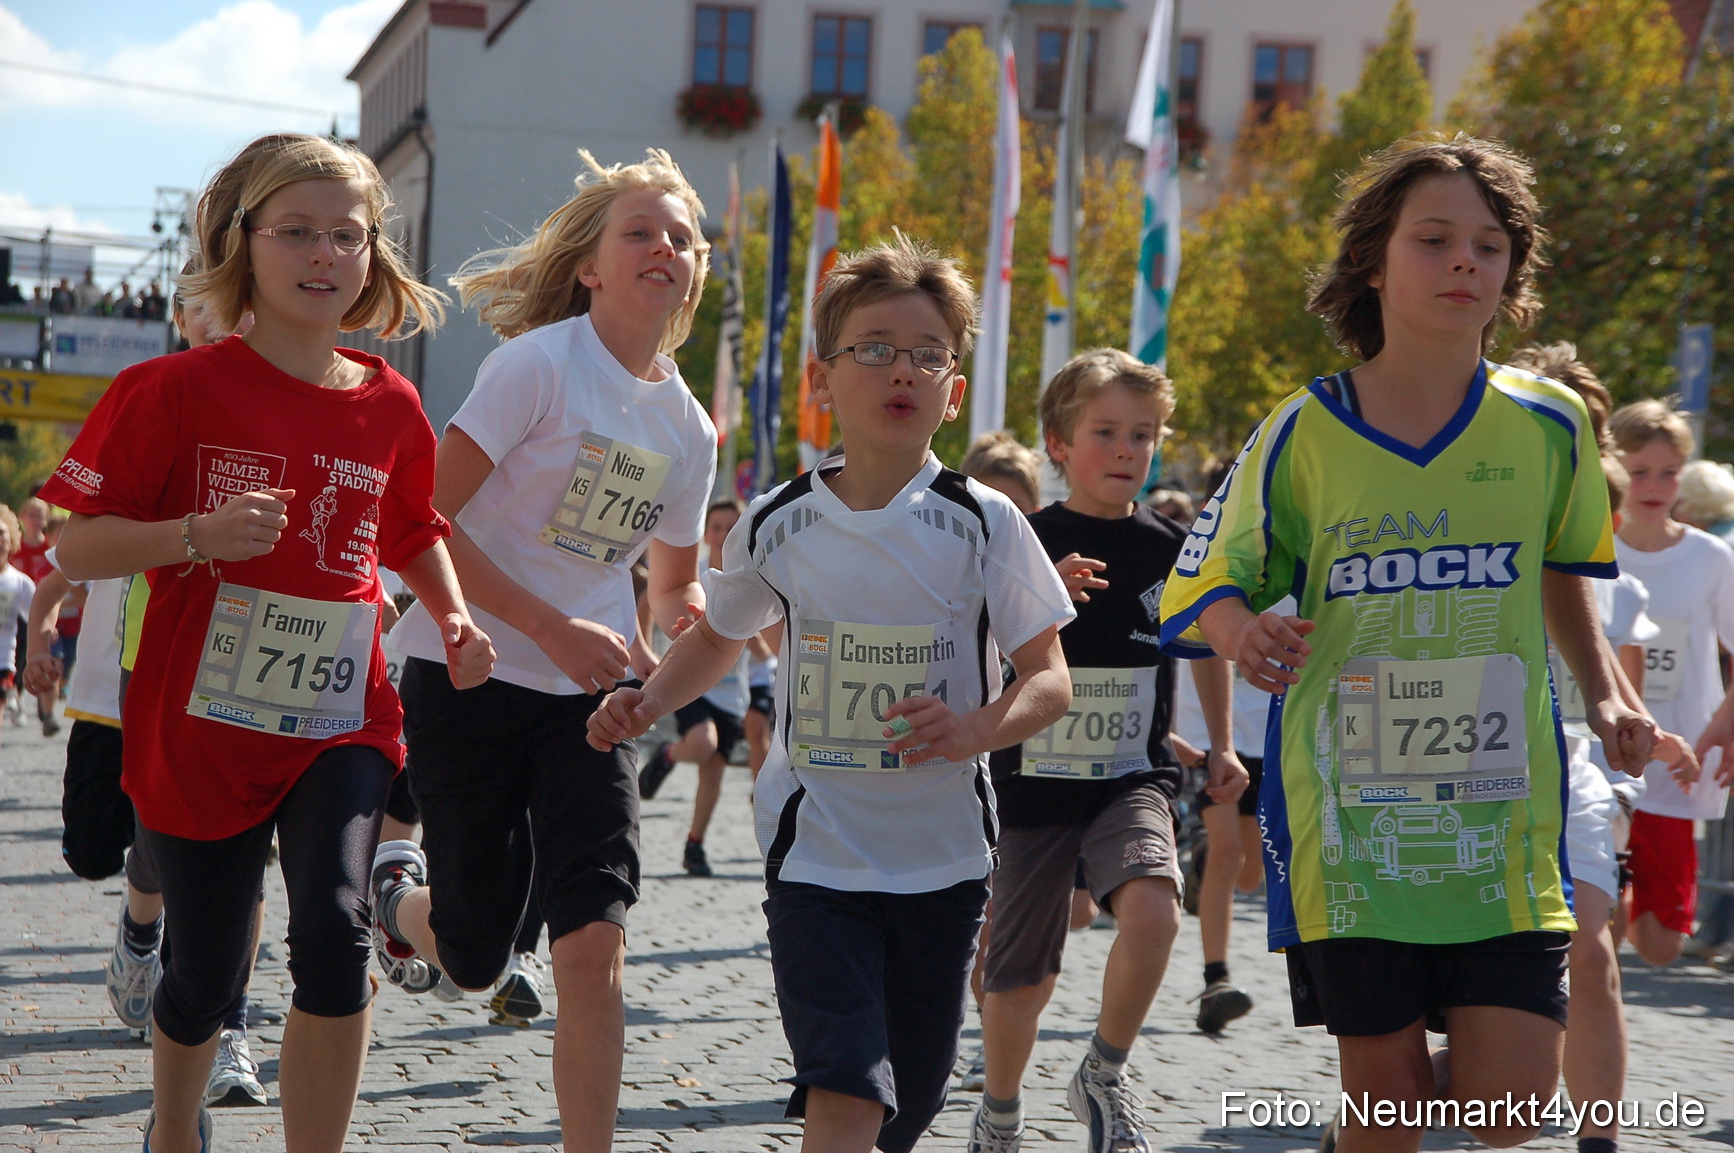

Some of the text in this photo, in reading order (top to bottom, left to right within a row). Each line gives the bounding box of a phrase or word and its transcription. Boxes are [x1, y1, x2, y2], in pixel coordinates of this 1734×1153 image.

[210, 458, 270, 481] IMMER
[238, 454, 260, 464] Jahre
[313, 454, 330, 469] 11.
[610, 451, 645, 482] Nina
[570, 476, 590, 496] K5
[597, 488, 664, 533] 7166
[1323, 508, 1449, 552] TEAM
[554, 534, 592, 552] BOCK
[1326, 543, 1520, 601] BOCK
[262, 602, 327, 642] Fanny
[212, 632, 236, 655] K5
[840, 634, 956, 665] Constantin
[256, 646, 356, 694] 7159
[800, 674, 810, 695] K
[1072, 677, 1138, 698] onathan
[1388, 672, 1443, 700] Luca
[208, 702, 256, 721] BOCK
[298, 716, 360, 730] PFLEIDERER
[1064, 711, 1142, 742] 7083
[1346, 715, 1357, 736] K
[1392, 711, 1509, 757] 7232
[809, 750, 854, 762] BOCK
[1036, 762, 1071, 771] BOCK
[1360, 786, 1408, 798] BOCK
[1457, 777, 1525, 793] PFLEIDERER
